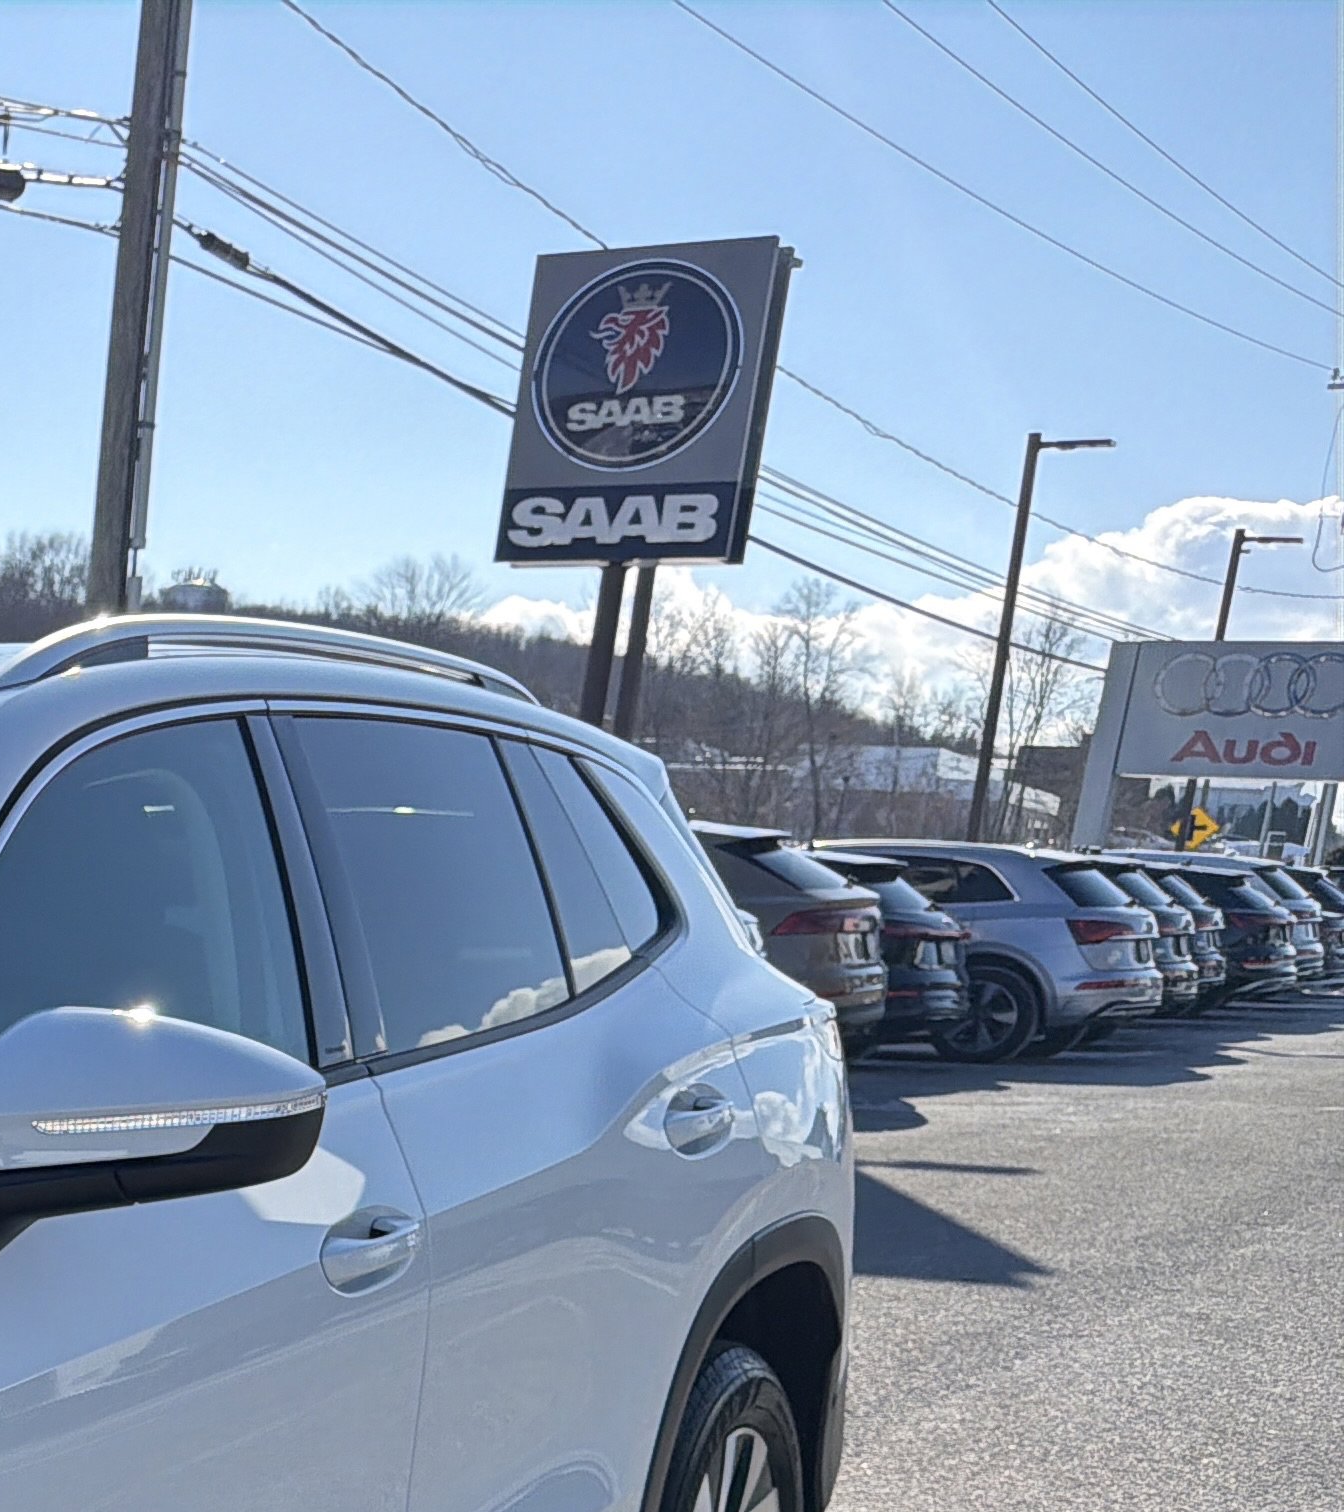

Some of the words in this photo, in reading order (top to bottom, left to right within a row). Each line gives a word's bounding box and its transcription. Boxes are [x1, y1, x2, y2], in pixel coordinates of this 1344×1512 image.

[566, 395, 685, 432] SAAB
[507, 493, 719, 548] SAAB
[1169, 729, 1317, 766] Audi
